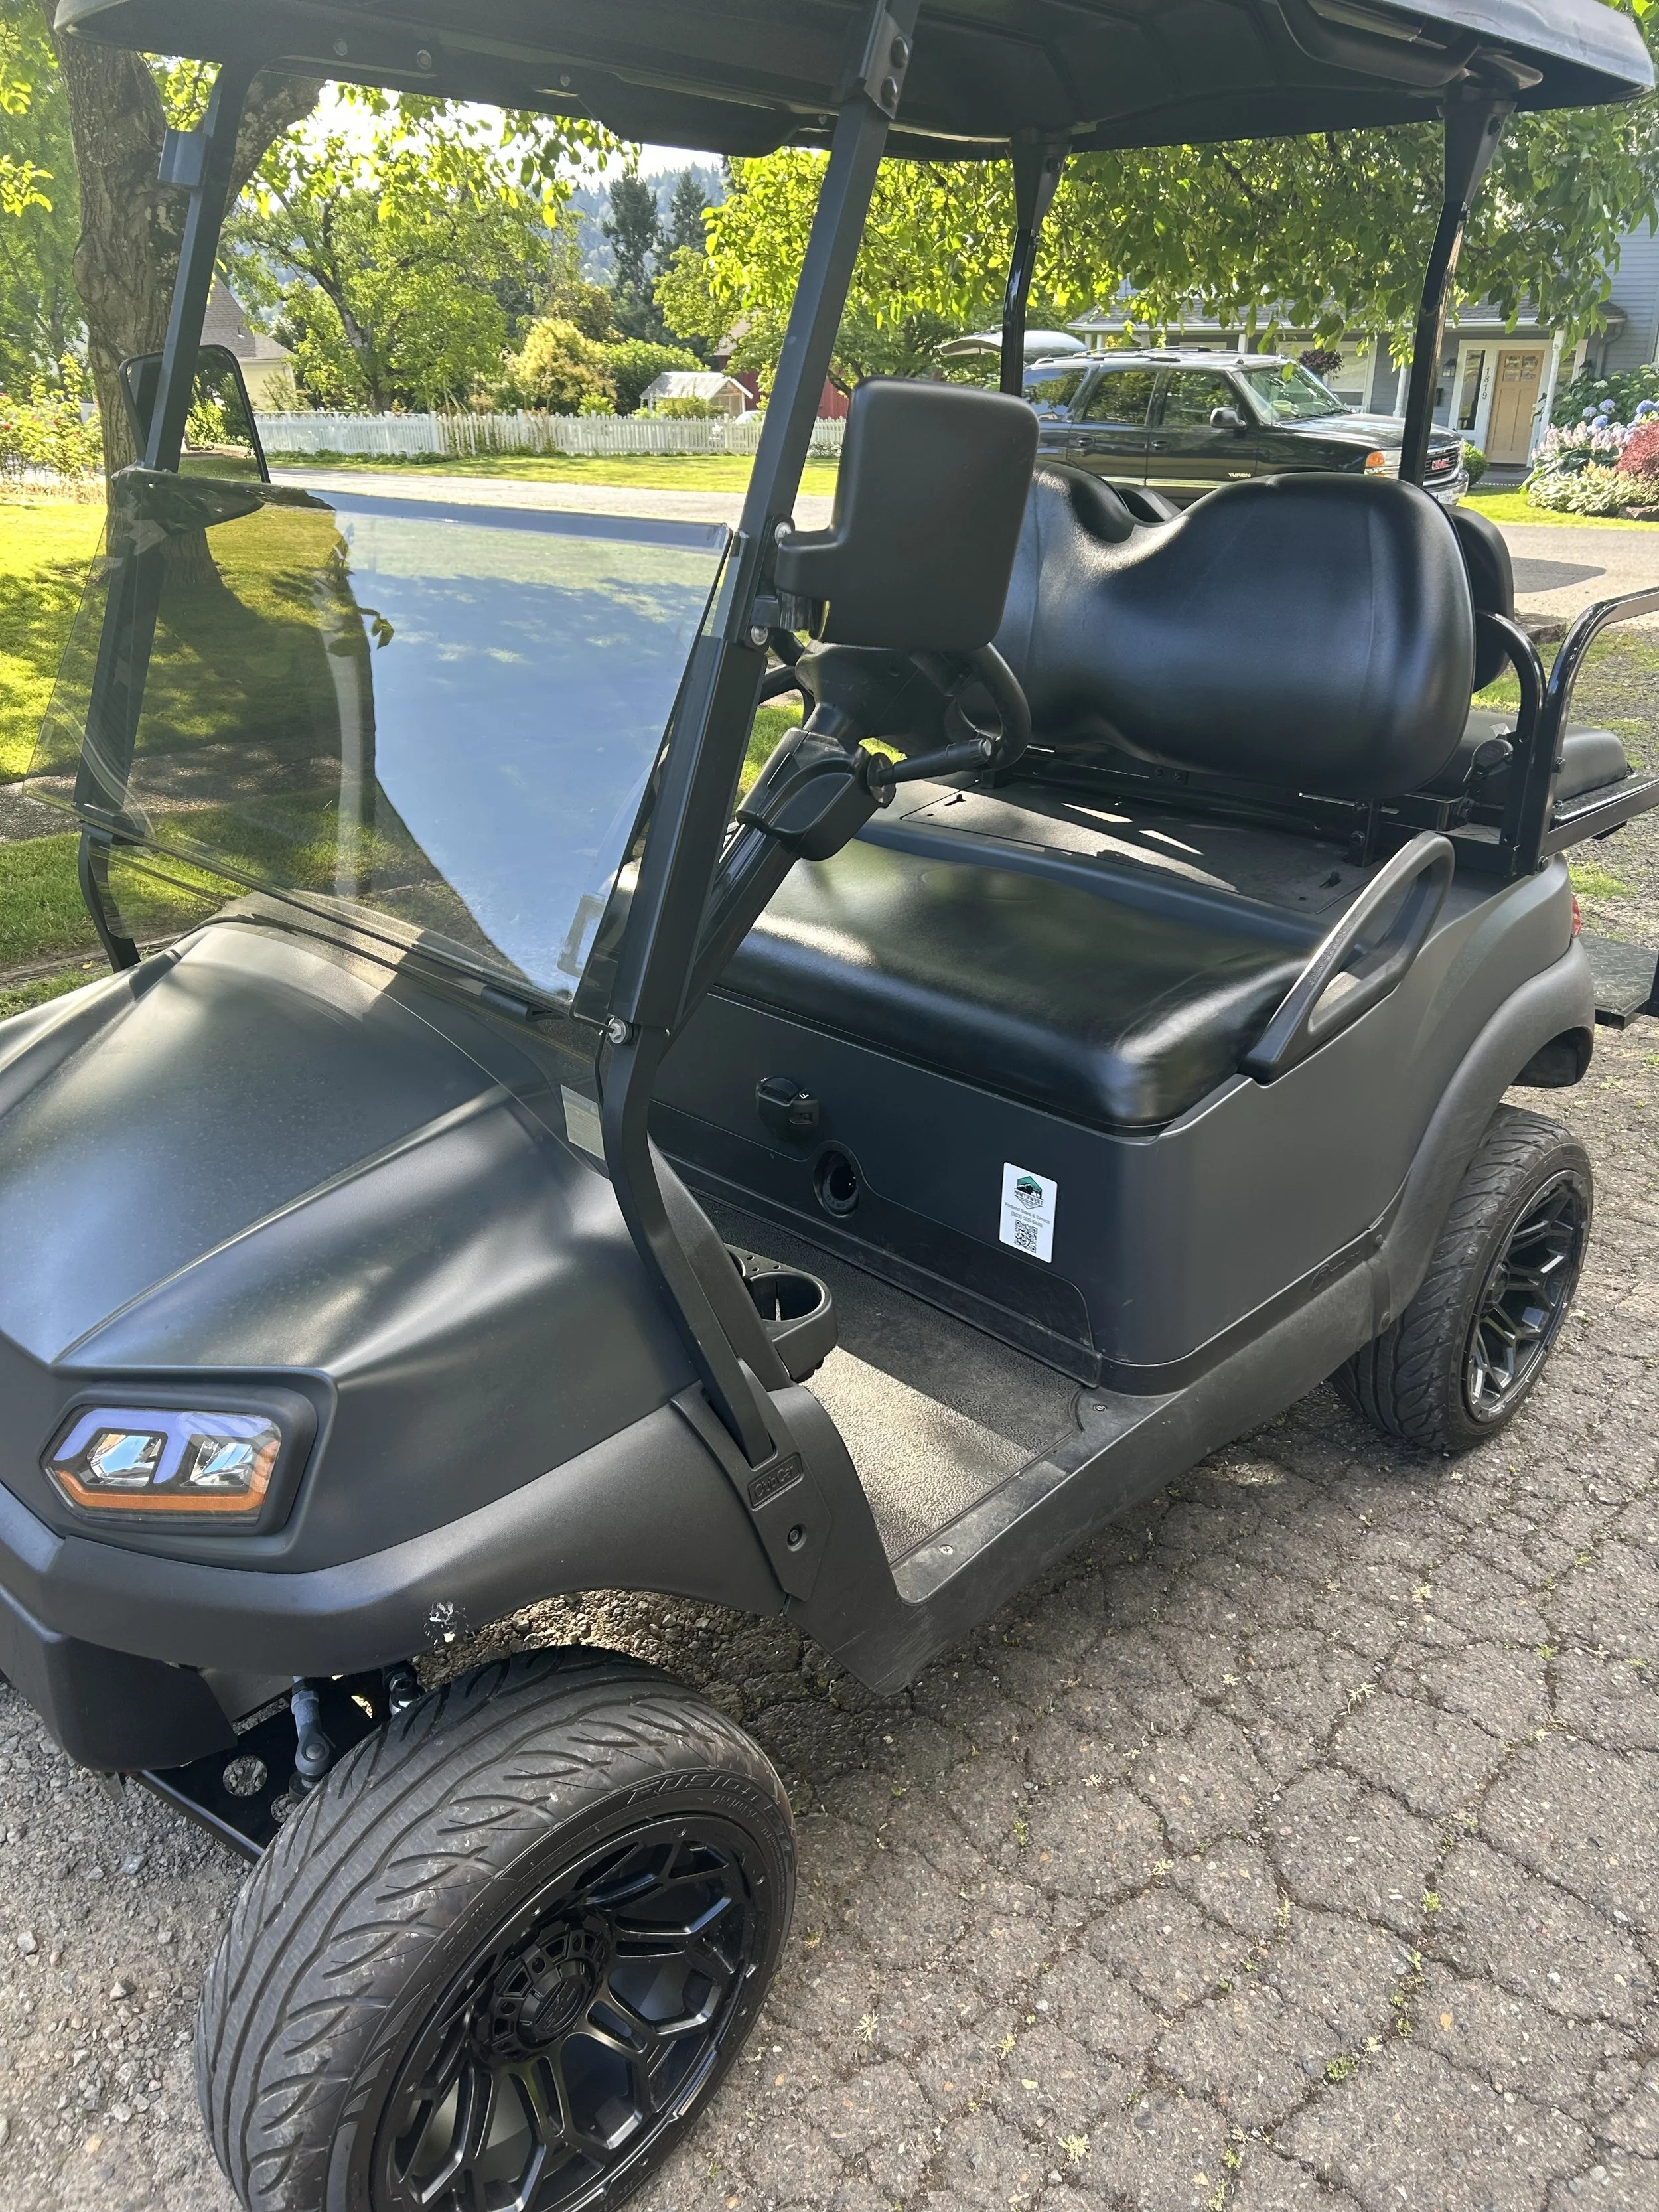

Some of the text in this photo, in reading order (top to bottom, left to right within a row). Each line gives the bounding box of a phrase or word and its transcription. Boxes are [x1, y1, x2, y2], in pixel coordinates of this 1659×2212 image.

[1431, 457, 1450, 471] GMC
[1014, 1189, 1043, 1205] NORTHWEST
[755, 1465, 794, 1497] Club Car
